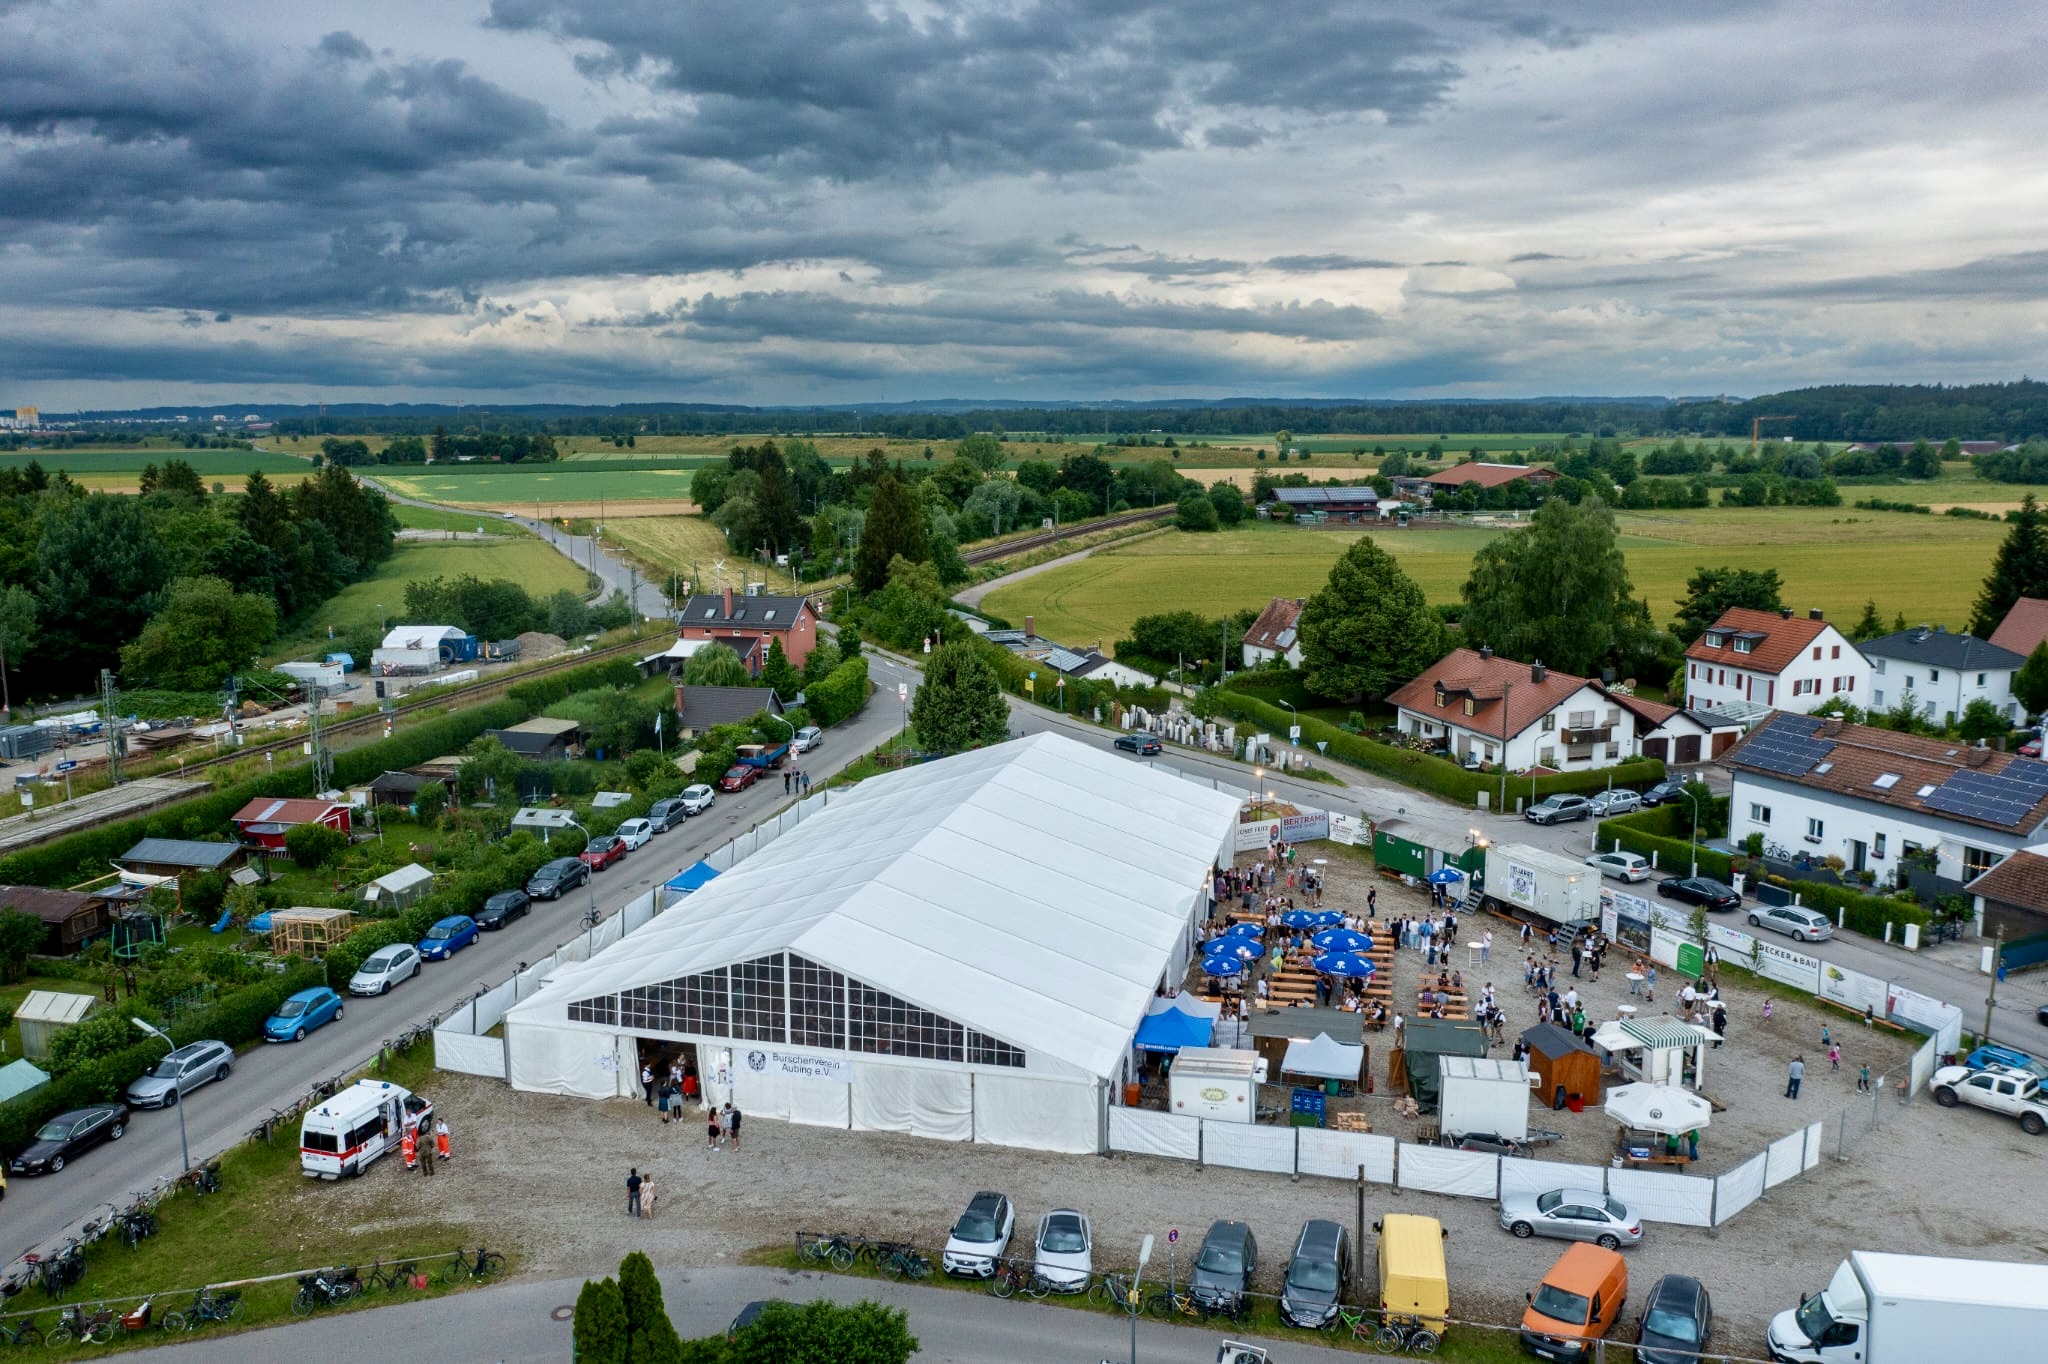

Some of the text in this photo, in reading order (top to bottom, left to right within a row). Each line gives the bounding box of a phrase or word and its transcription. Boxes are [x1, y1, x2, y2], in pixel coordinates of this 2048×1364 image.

[1283, 814, 1326, 826] BERTRAMS
[1759, 943, 1817, 969] DECKER BAU
[772, 1052, 840, 1069] Burschenverein
[781, 1063, 832, 1077] Aubing e.V.
